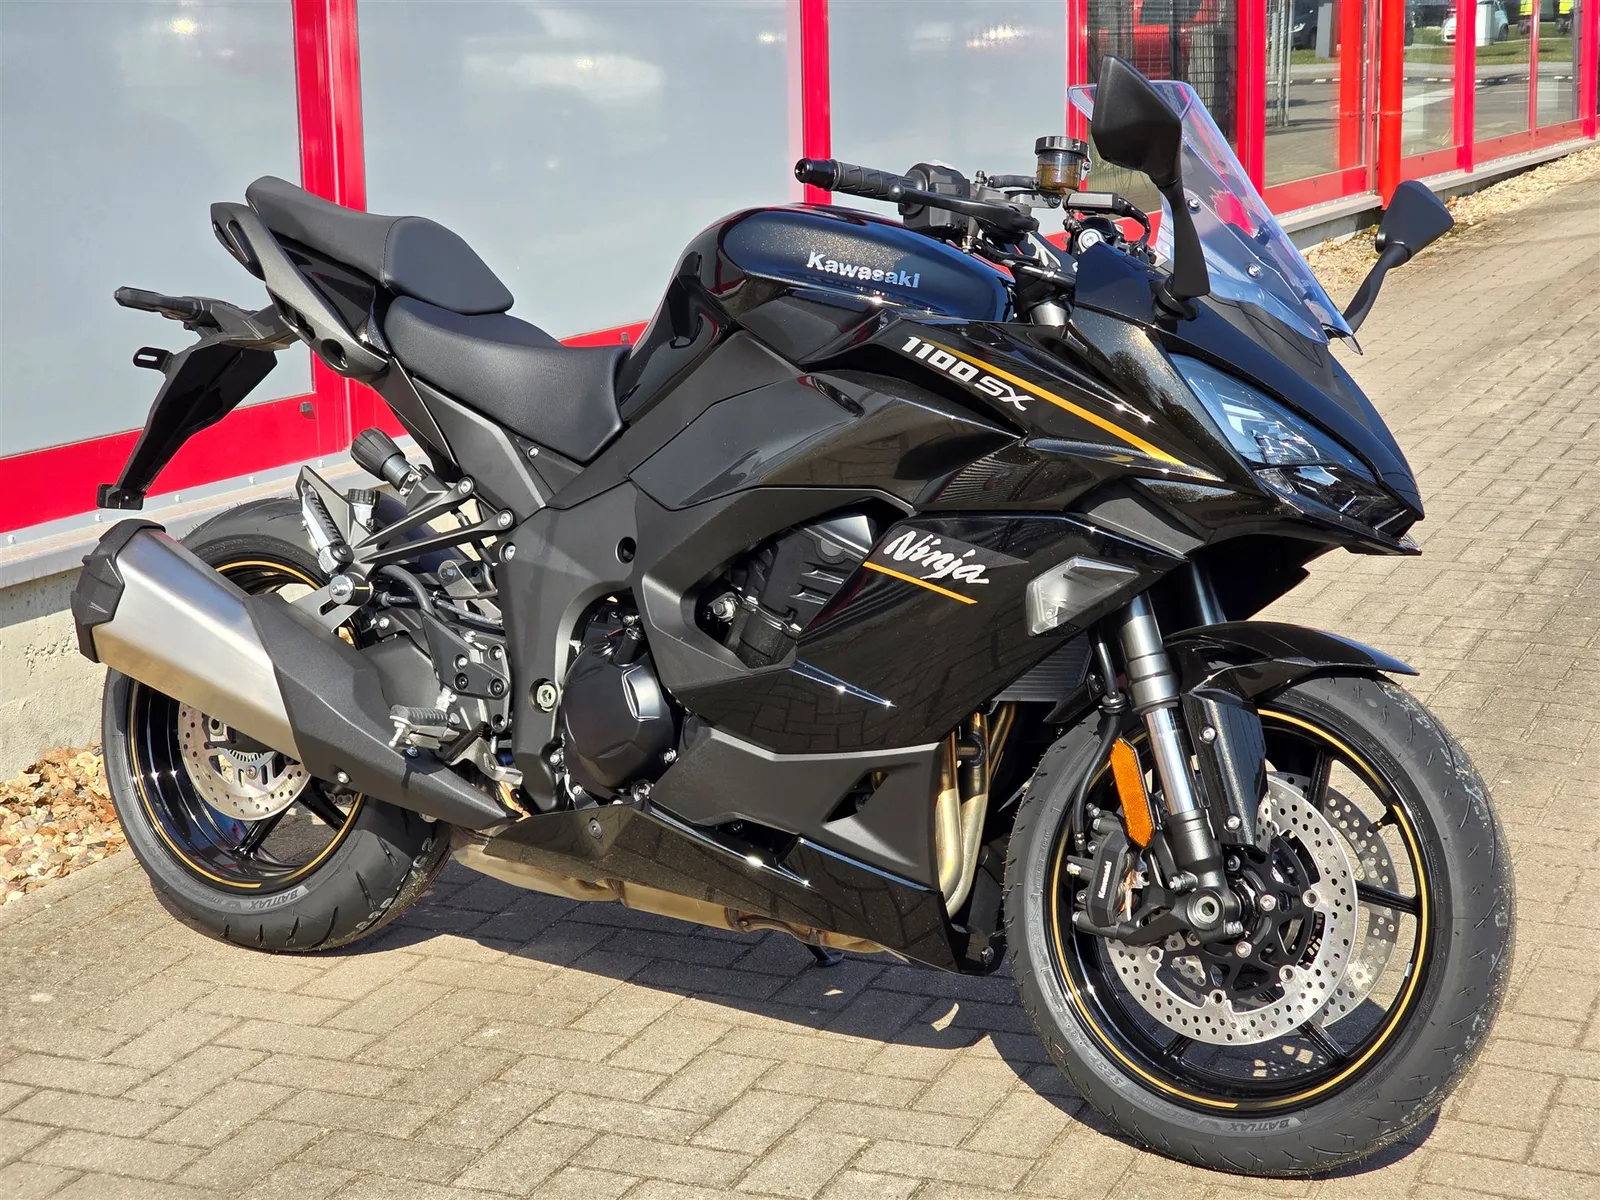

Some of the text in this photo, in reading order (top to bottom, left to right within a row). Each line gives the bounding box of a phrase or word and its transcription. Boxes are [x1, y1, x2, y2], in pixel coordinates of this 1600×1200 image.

[806, 251, 921, 288] Kawasaki
[883, 530, 990, 584] Ninja
[248, 889, 299, 910] BATTLAX
[1228, 1118, 1291, 1132] BATTLAX
